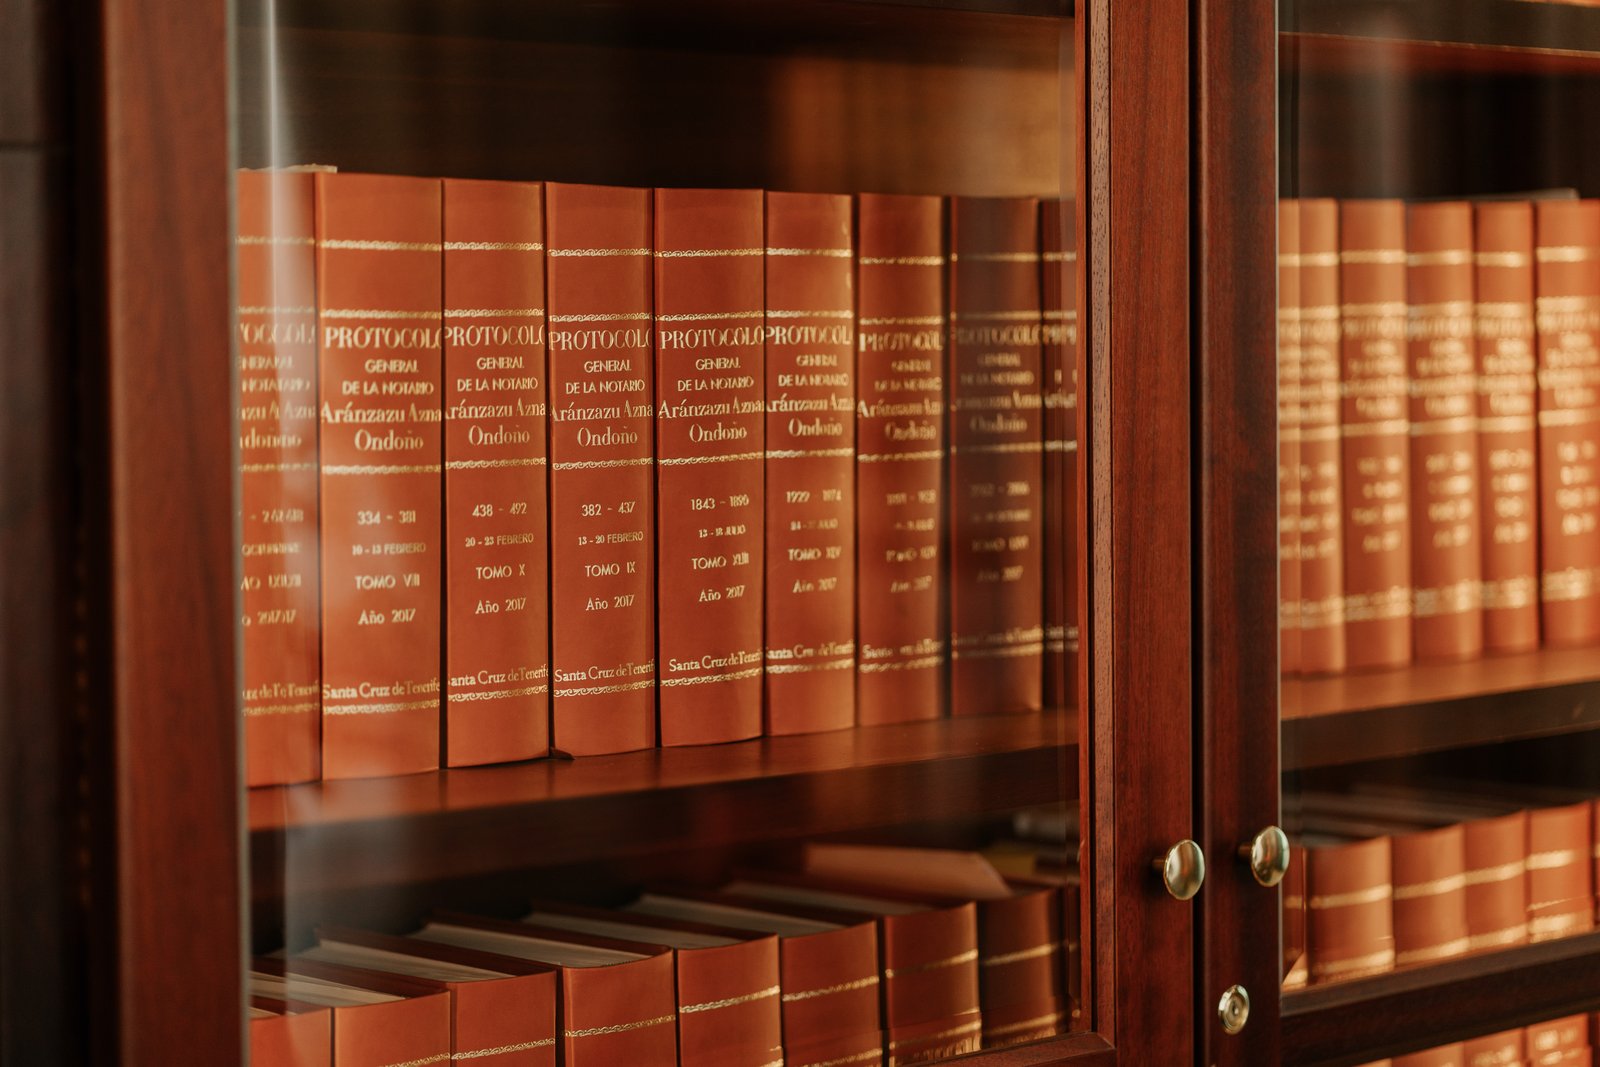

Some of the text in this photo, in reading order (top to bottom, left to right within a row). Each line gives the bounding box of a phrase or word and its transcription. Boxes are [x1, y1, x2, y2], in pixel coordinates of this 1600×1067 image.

[660, 326, 764, 350] PROTOCOLO
[364, 358, 419, 374] GENERAL
[477, 356, 524, 370] GENERAL
[584, 360, 632, 373] GENERAL
[695, 357, 741, 371] GENERAL
[342, 380, 434, 395] DE LA NOTARIO
[457, 377, 538, 392] DE LA NOTARIO
[566, 380, 645, 394] DE LA NOTARIO
[678, 376, 755, 392] DE LA NOTARIO
[778, 374, 793, 387] DE
[795, 374, 808, 387] LA
[321, 401, 405, 424] Aránzazu
[550, 402, 620, 422] Aránzazu
[659, 399, 730, 419] Aránzazu
[354, 428, 424, 451] Ondoño
[468, 424, 530, 445] Ondoño
[577, 426, 638, 447] Ondoño
[689, 421, 748, 443] Ondoño
[472, 504, 493, 517] 438
[510, 502, 527, 515] 492
[581, 504, 602, 517] 382
[618, 501, 636, 514] 437
[691, 498, 715, 510] 1843
[357, 510, 381, 525] 334
[465, 537, 476, 547] 20
[484, 536, 494, 546] 23
[497, 533, 534, 545] FEBRERO
[578, 536, 587, 546] 13
[607, 531, 644, 543] FEBRERO
[384, 542, 426, 555] FEBRERO
[788, 548, 821, 561] TOMO
[476, 563, 526, 579] TOMO X
[585, 561, 636, 578] TOMO IX
[692, 556, 727, 570] TOMO
[354, 575, 396, 590] TOMO
[699, 585, 745, 602] Año 2017
[475, 597, 526, 614] Año 2017
[585, 595, 635, 611] Año 2017
[358, 608, 416, 626] Año 2017
[766, 647, 793, 659] anta
[669, 658, 701, 672] Santa
[701, 655, 728, 669] Cruz
[448, 677, 476, 688] anta
[477, 670, 506, 684] Cruz
[508, 669, 519, 681] de
[554, 669, 587, 682] Santa
[588, 666, 614, 680] Cruz
[616, 664, 628, 677] de
[322, 683, 358, 699] Santa
[359, 681, 390, 698] Cruz
